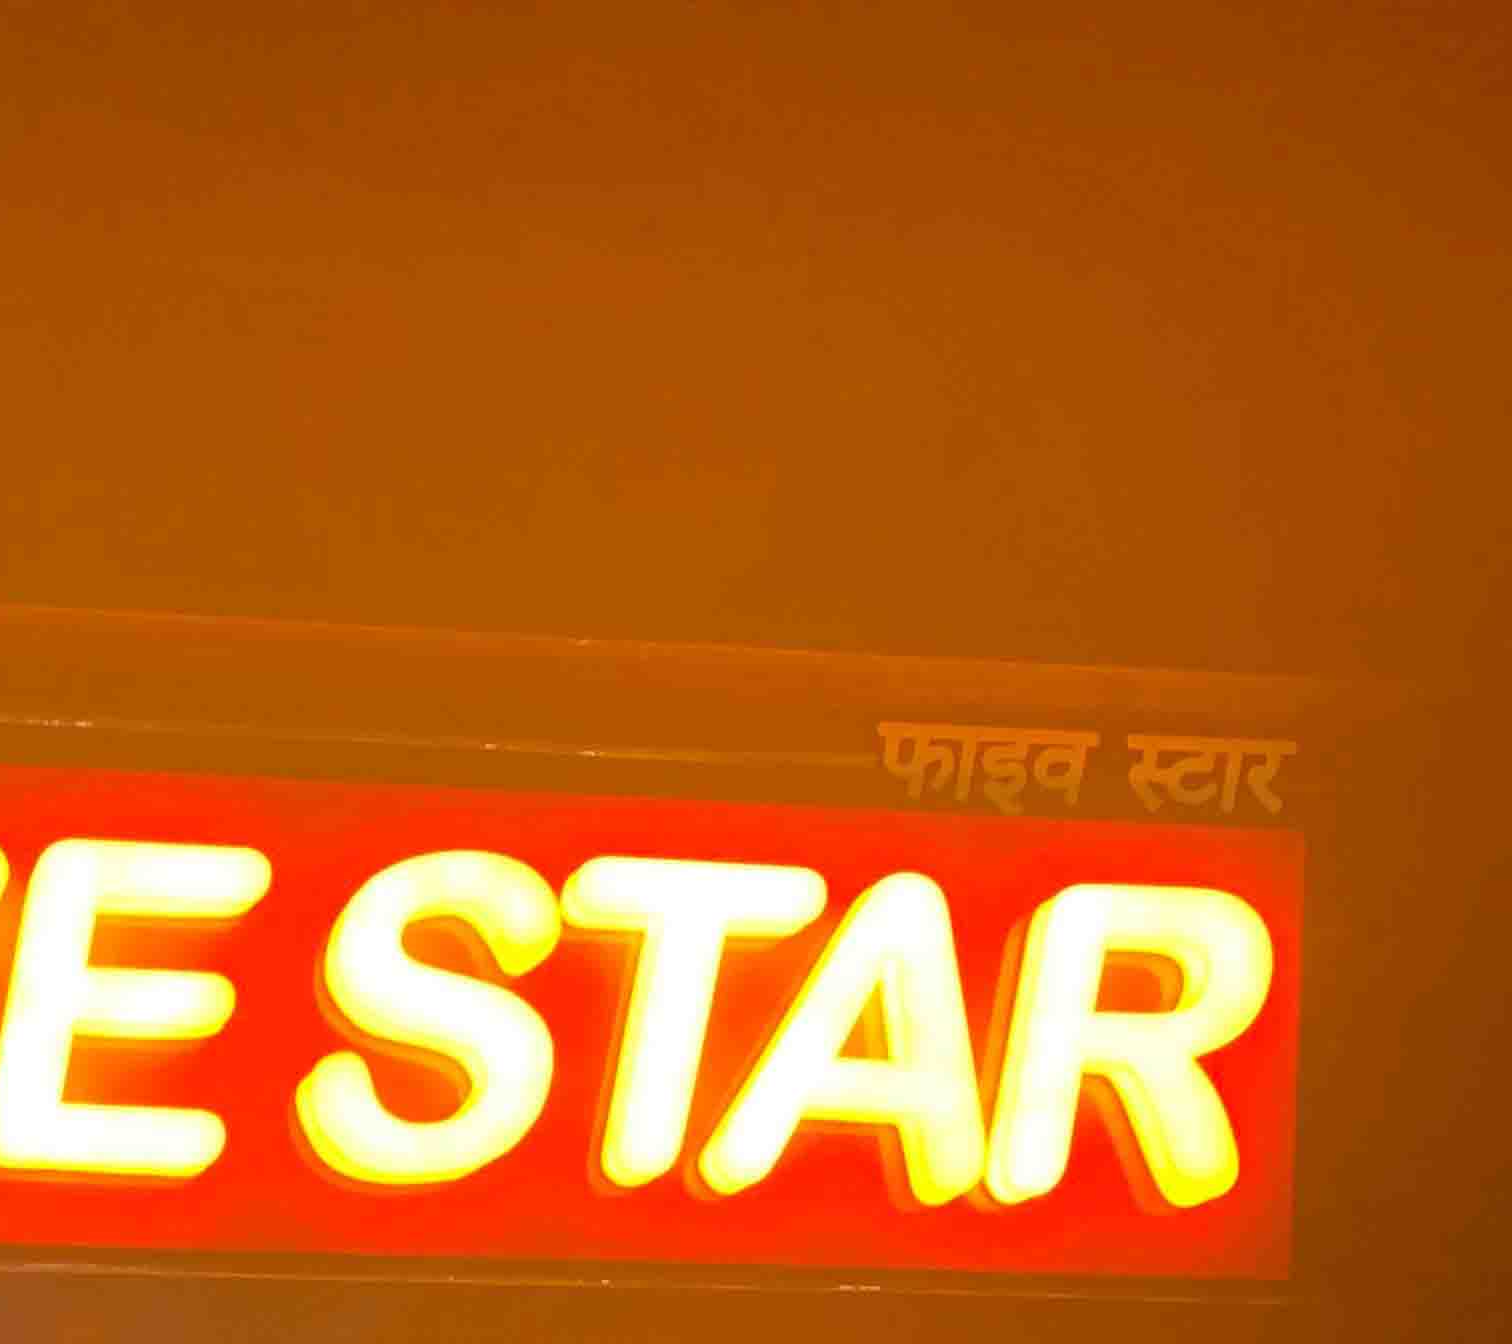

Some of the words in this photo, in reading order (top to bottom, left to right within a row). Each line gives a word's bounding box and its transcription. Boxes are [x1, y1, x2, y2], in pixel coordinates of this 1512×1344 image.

[876, 720, 1100, 815] फाइव
[1127, 733, 1297, 814] स्टार
[293, 846, 1276, 1211] STAR
